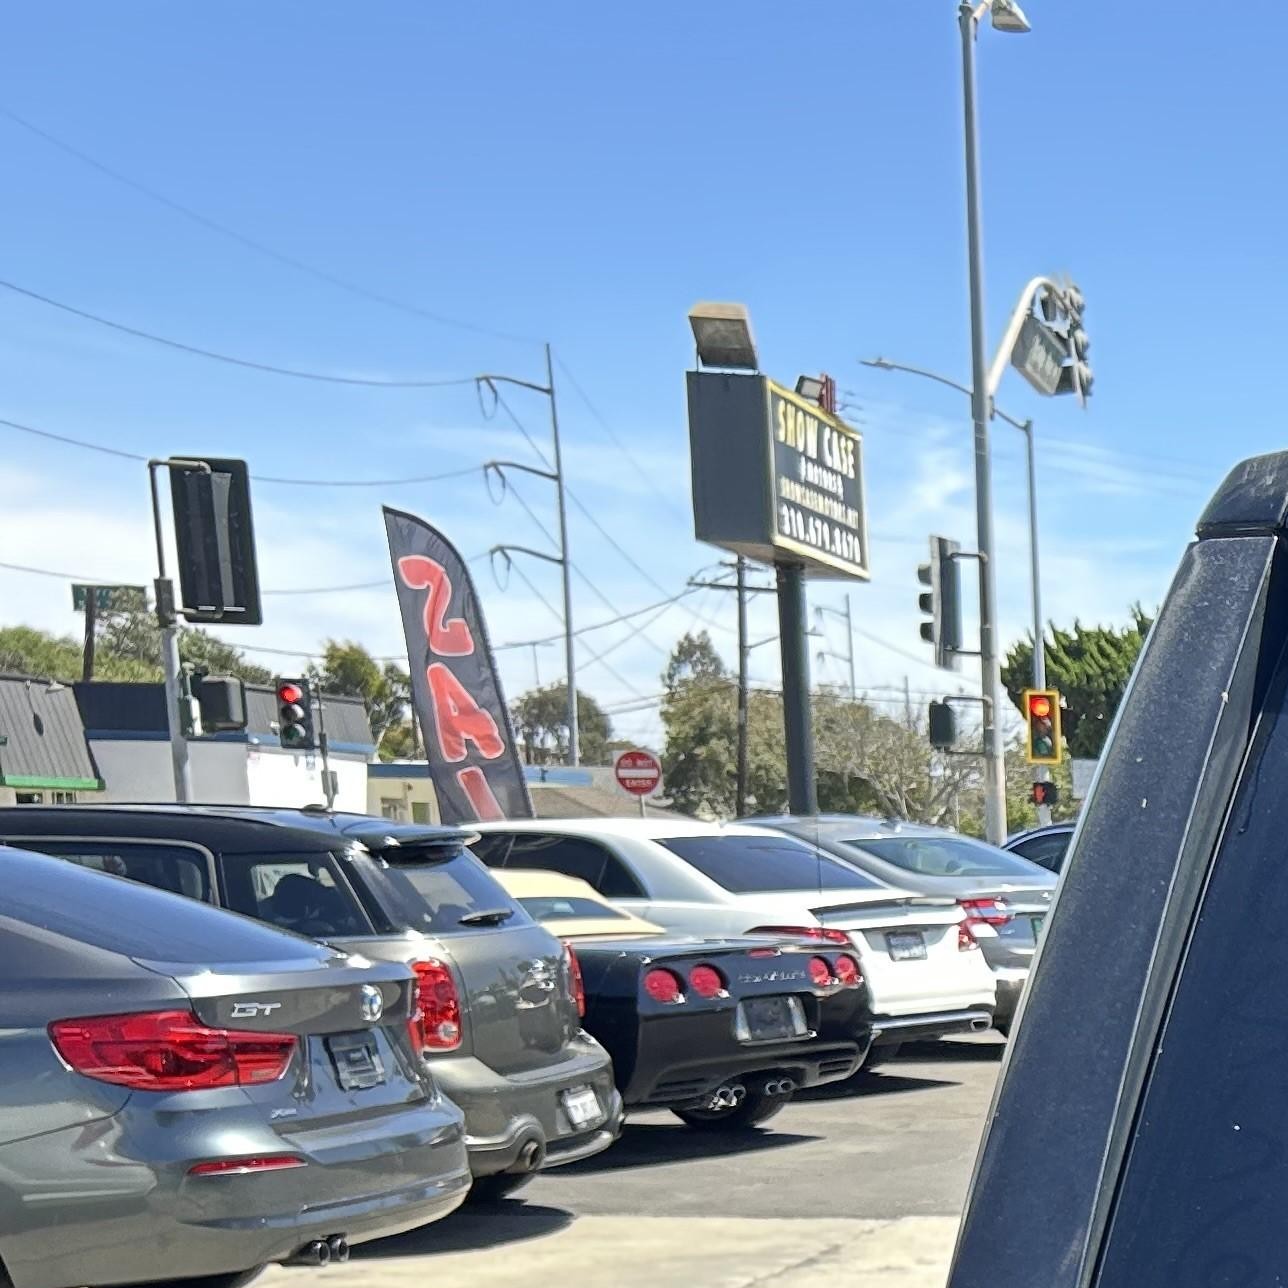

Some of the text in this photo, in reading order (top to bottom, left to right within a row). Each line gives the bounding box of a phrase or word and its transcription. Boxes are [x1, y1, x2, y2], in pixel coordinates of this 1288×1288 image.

[777, 399, 855, 480] SHOW CASE
[231, 1002, 281, 1018] GT
